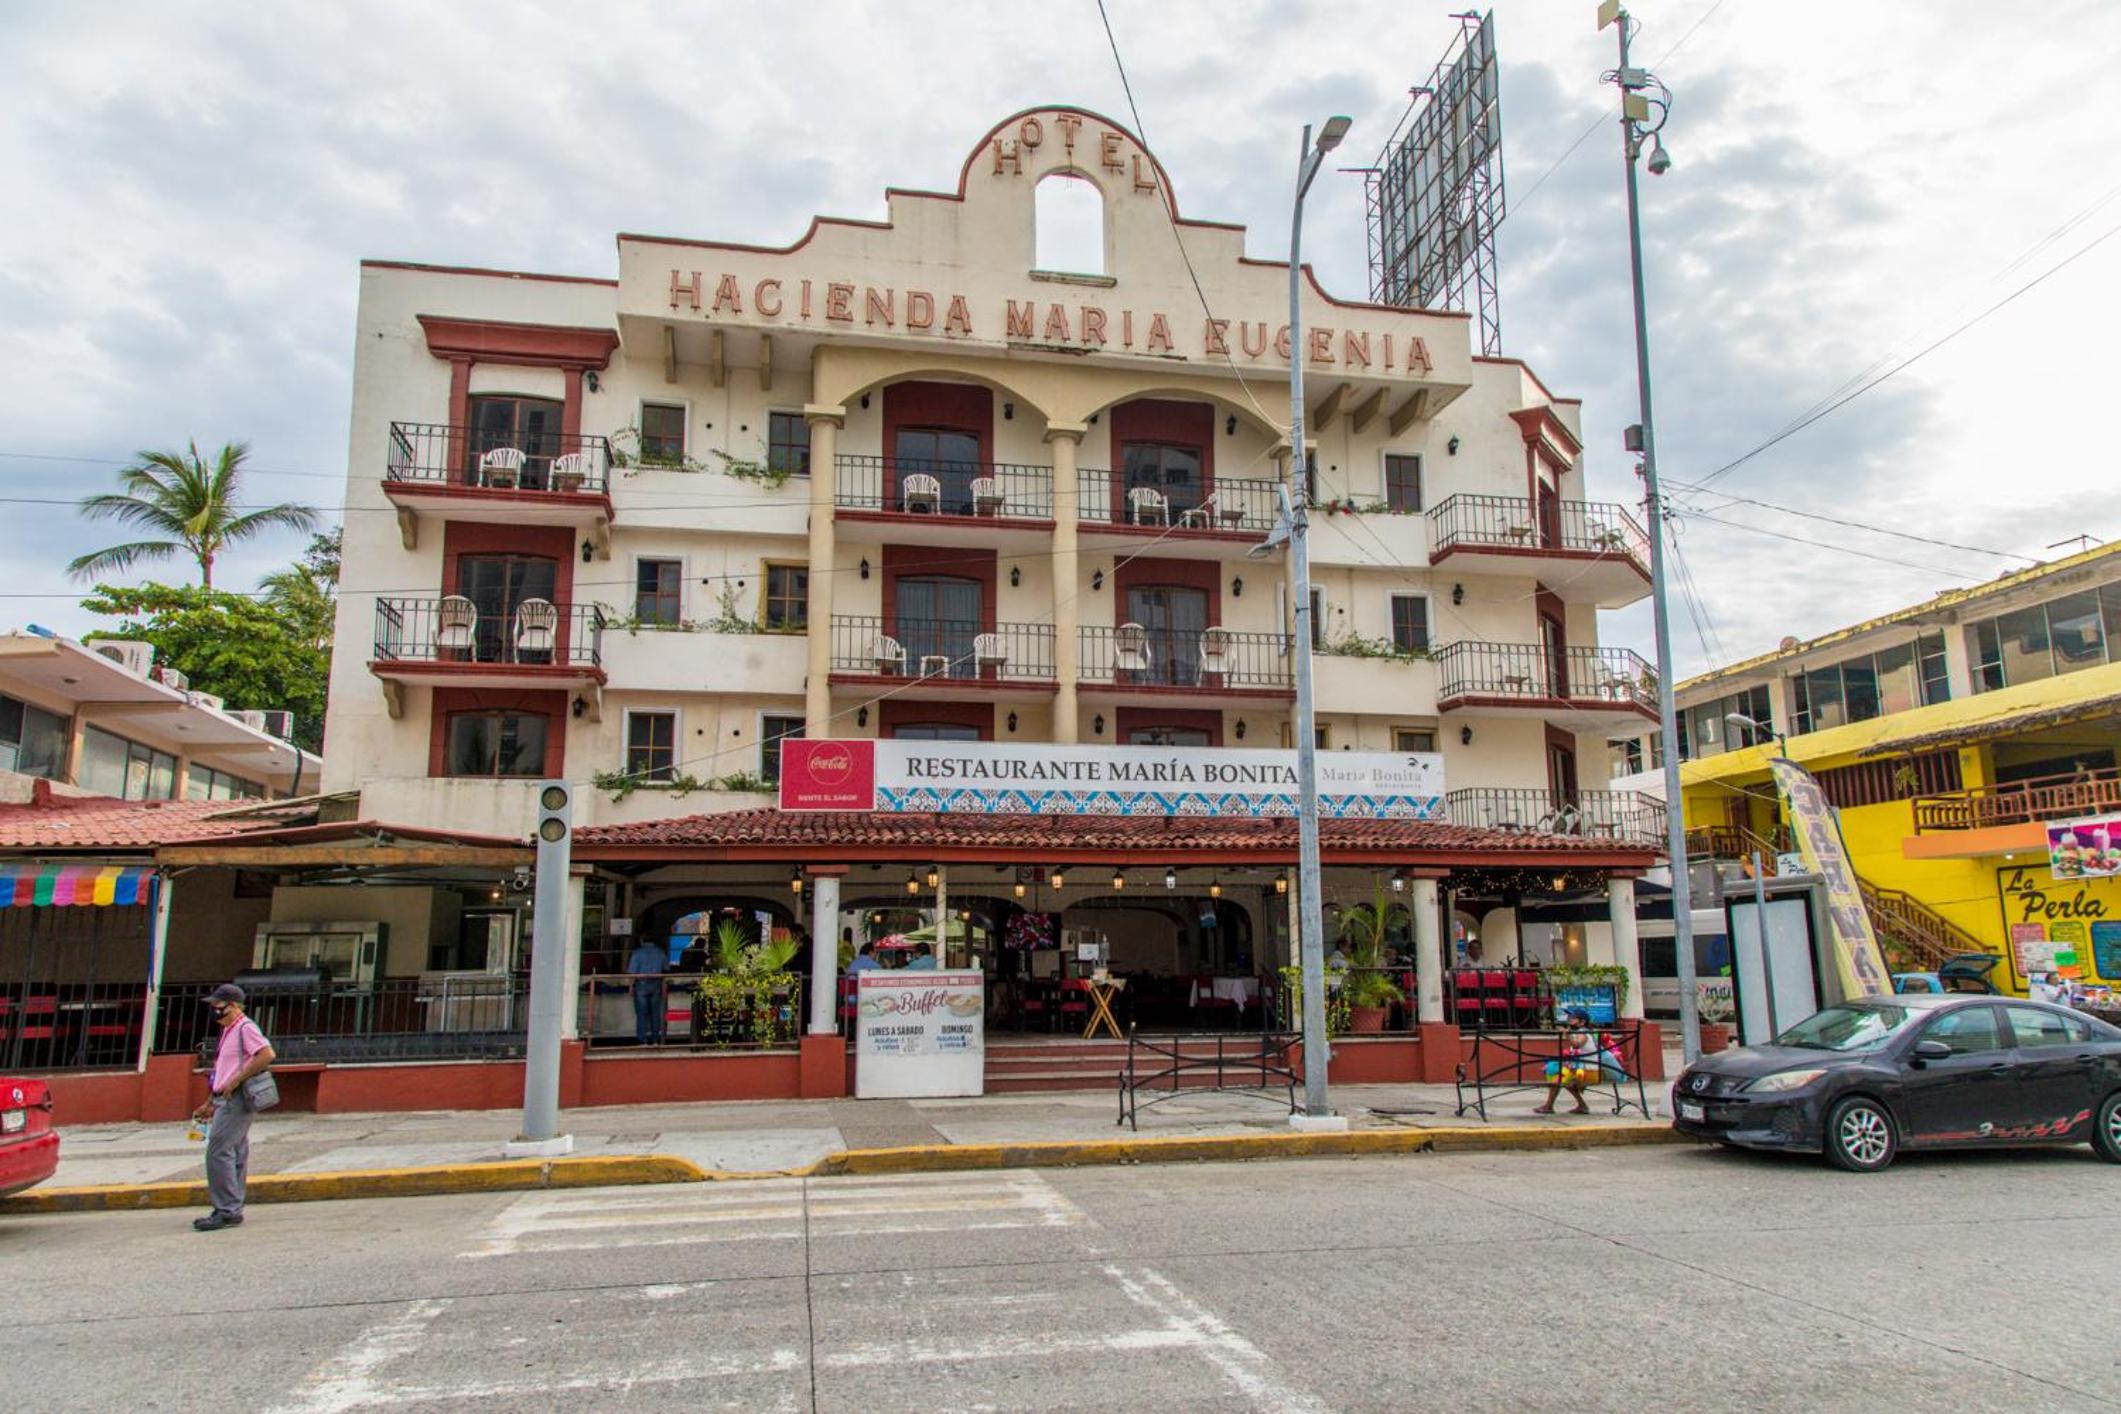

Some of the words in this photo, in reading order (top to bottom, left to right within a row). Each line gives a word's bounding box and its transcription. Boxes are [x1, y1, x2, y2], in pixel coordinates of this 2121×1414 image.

[992, 113, 1157, 196] HOTEL
[669, 269, 973, 337] HACIENDA
[1005, 299, 1175, 352] MARIA
[1204, 318, 1434, 373] EUGENIA
[907, 757, 1100, 780] RESTAURANTE
[1109, 759, 1196, 782] MARÍA
[1203, 764, 1300, 784] BONITA
[1373, 769, 1421, 782] Bonita
[2006, 870, 2034, 892] La
[2019, 890, 2108, 922] Perla
[896, 990, 949, 1016] Buffet
